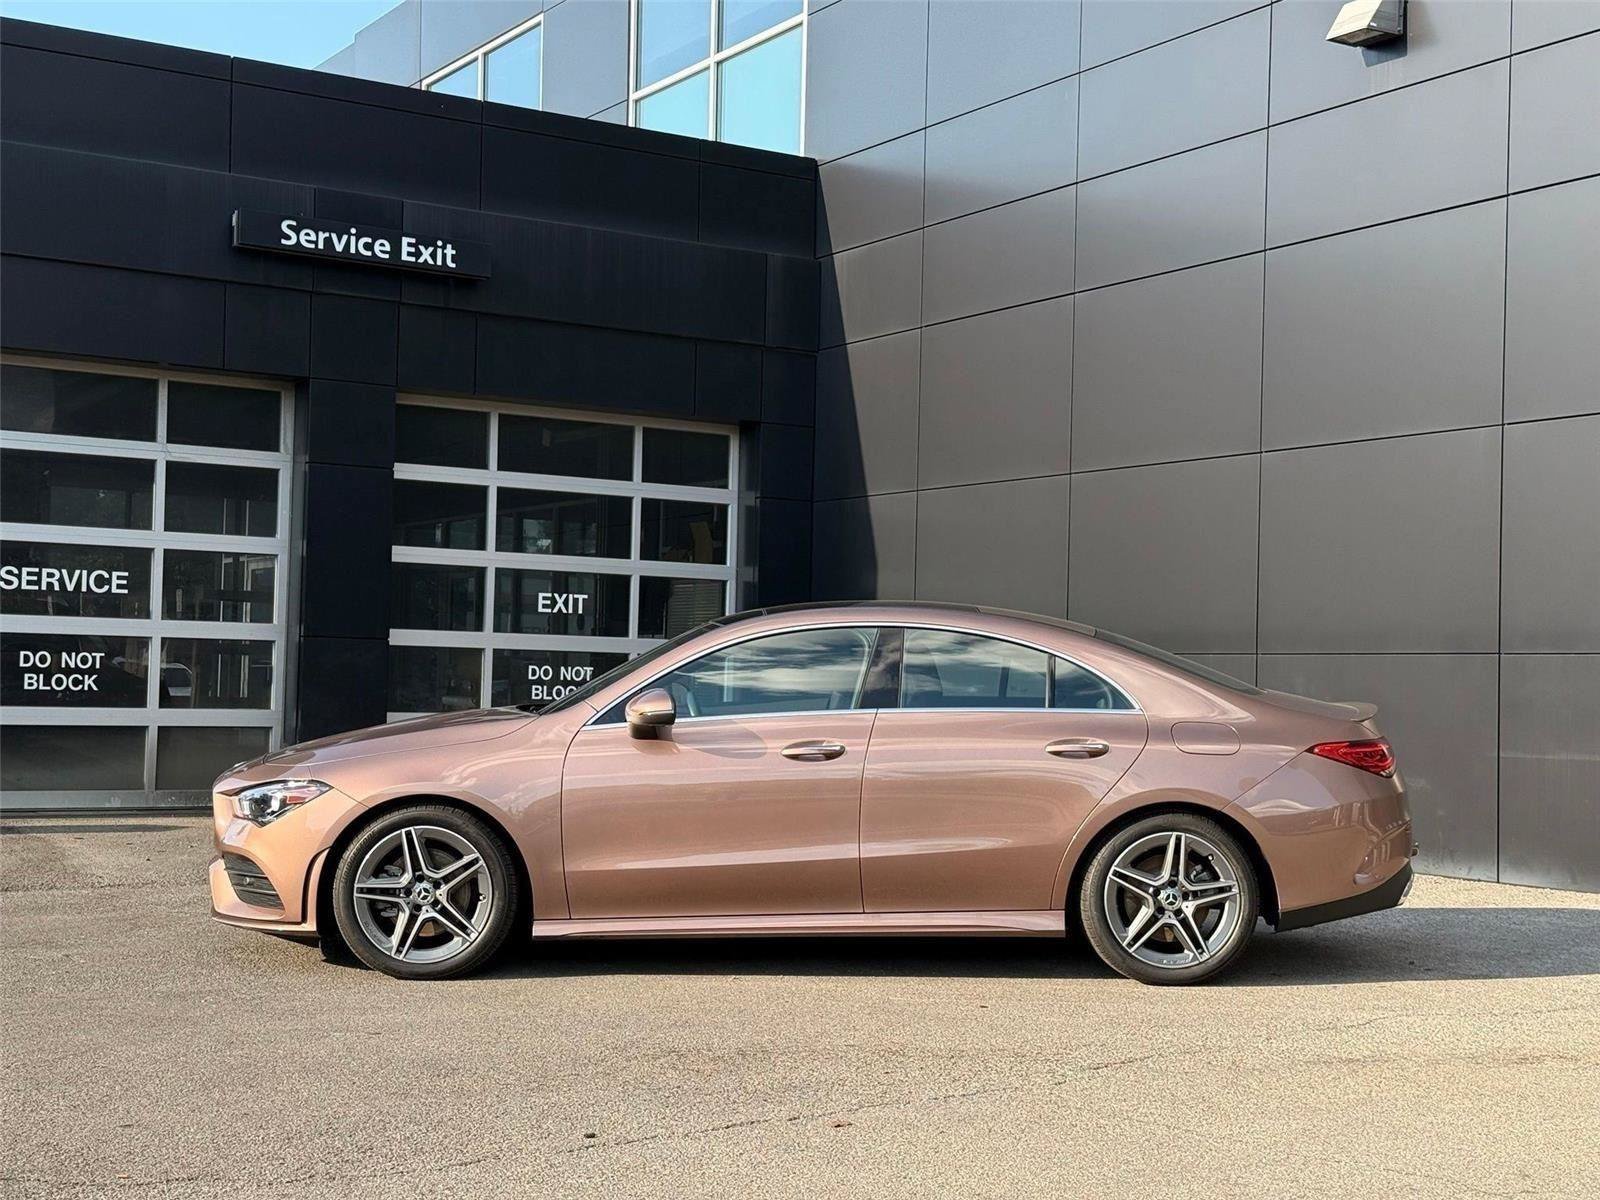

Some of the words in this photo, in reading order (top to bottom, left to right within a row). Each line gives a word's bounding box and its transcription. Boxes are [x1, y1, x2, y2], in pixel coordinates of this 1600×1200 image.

[280, 219, 391, 259] Service
[401, 236, 456, 268] Exit
[0, 565, 129, 594] SERVICE
[537, 592, 588, 614] EXIT
[19, 650, 52, 668] DO
[61, 651, 105, 669] NOT
[23, 673, 98, 691] BLOCK
[528, 664, 553, 681] DO
[560, 666, 594, 682] NOT
[531, 685, 580, 700] BLOC
